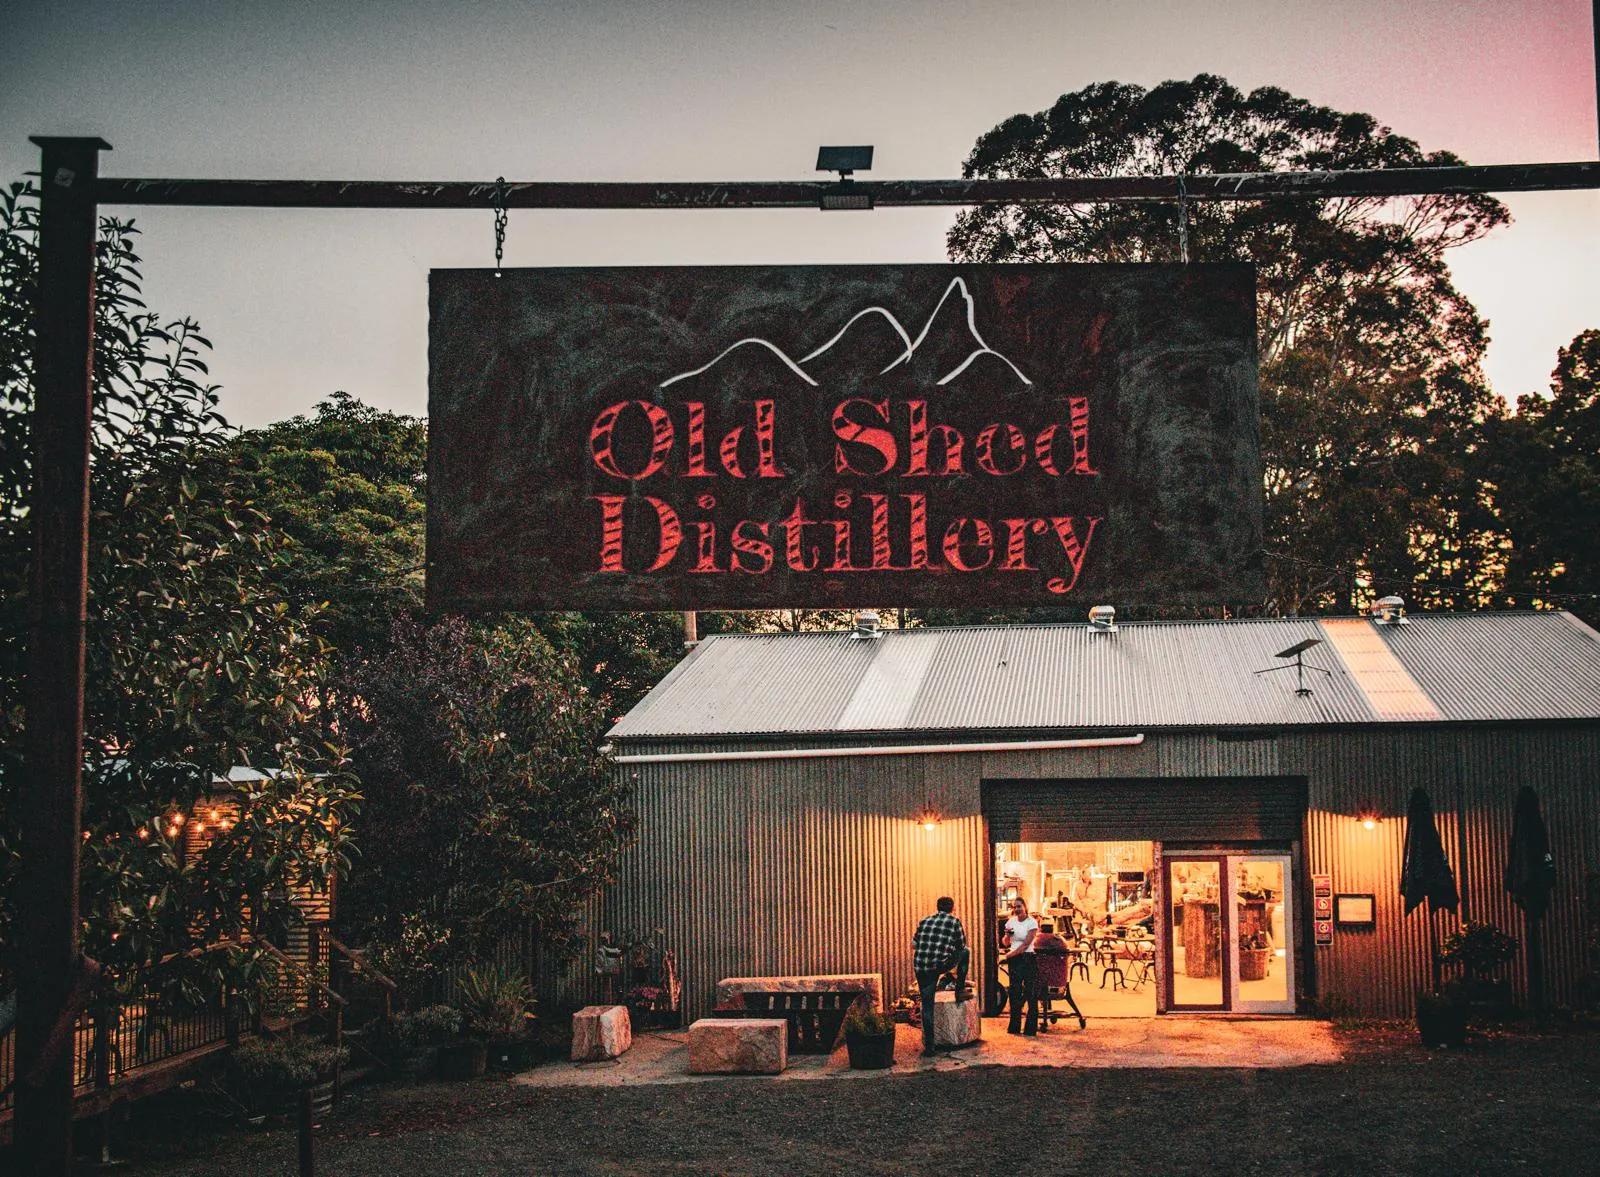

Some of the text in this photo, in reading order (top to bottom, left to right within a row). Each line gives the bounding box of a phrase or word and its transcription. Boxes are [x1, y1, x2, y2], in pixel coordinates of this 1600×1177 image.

[588, 397, 1101, 480] Old Shed
[592, 493, 1102, 594] Distillery
